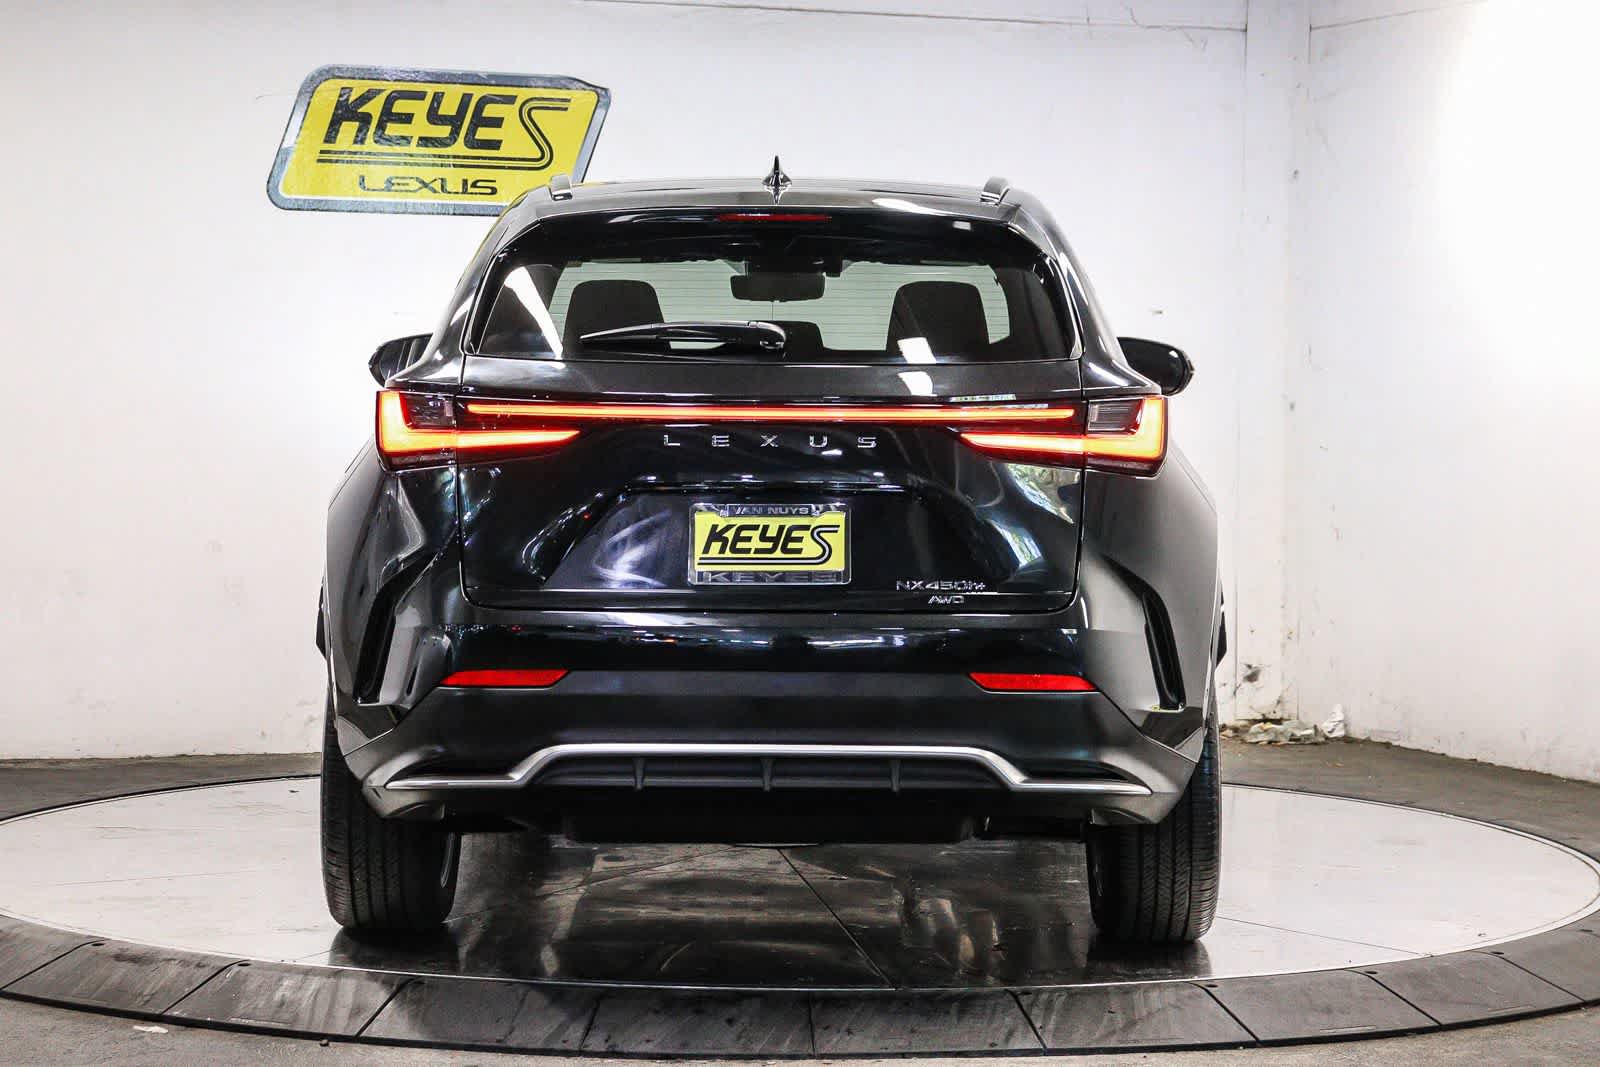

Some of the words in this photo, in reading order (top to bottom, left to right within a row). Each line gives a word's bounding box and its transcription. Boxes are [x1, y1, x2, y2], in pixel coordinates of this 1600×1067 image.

[316, 86, 571, 171] KEYES
[358, 175, 498, 196] LEXUS
[663, 434, 877, 449] LEXUS
[735, 506, 763, 515] VAN
[767, 506, 809, 515] NUYS
[697, 524, 840, 565] KEYES
[928, 595, 964, 604] AWD
